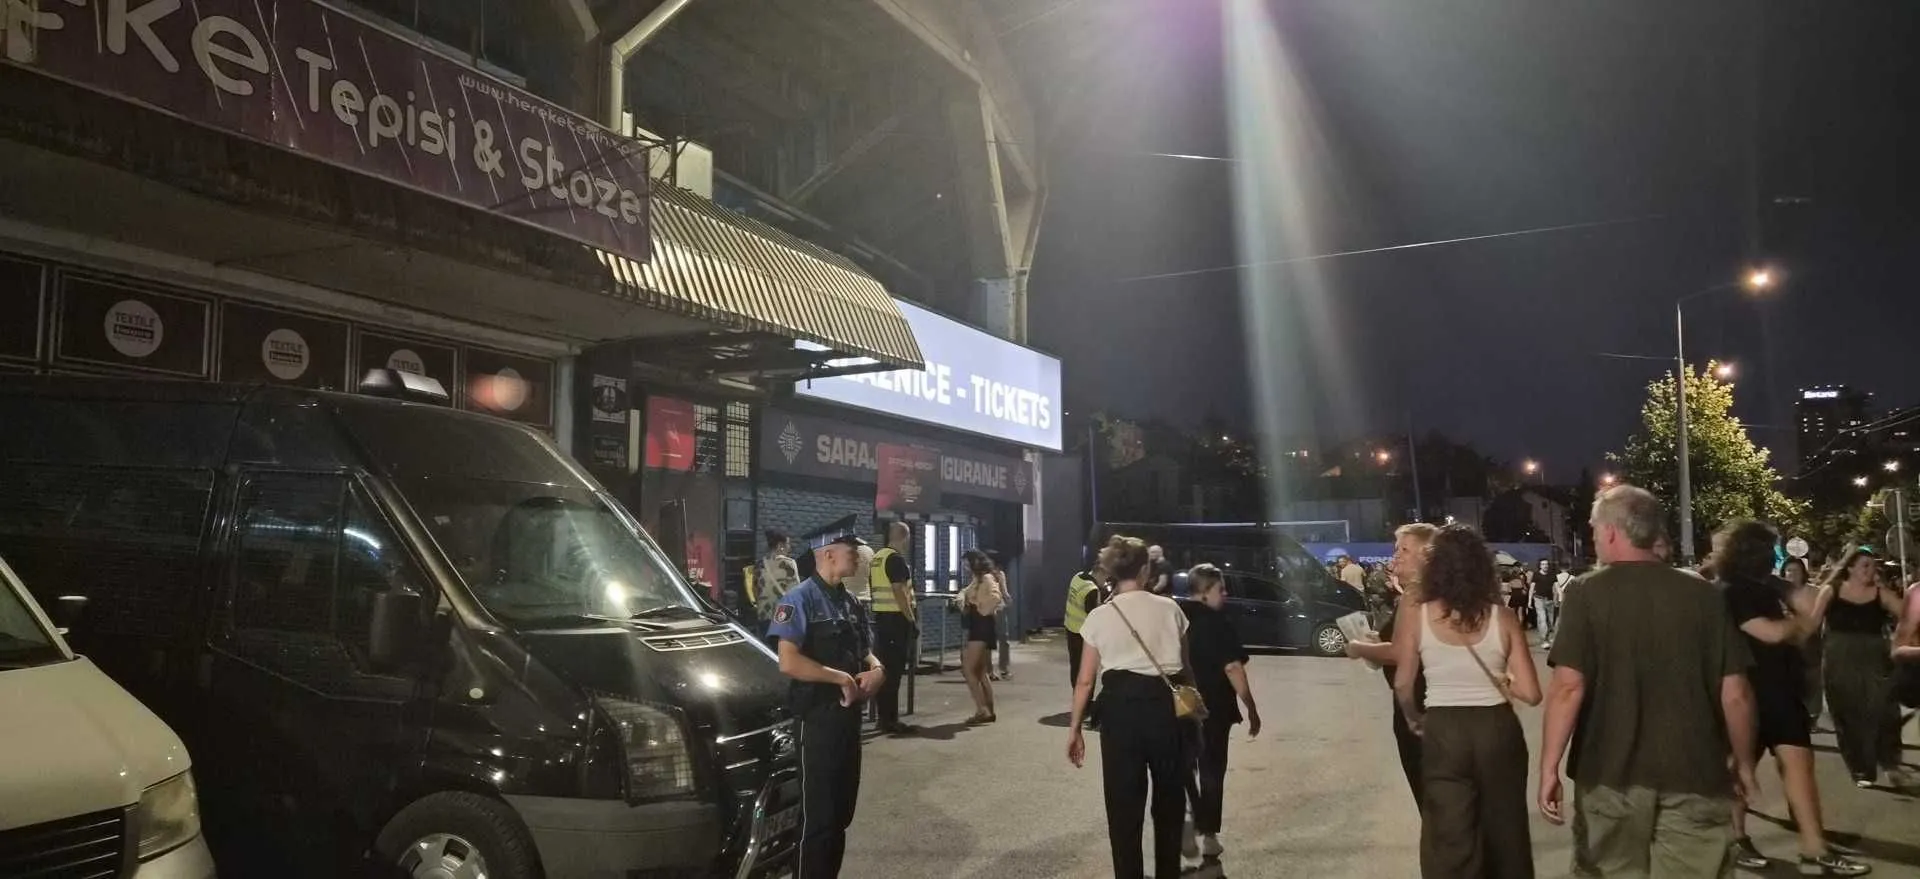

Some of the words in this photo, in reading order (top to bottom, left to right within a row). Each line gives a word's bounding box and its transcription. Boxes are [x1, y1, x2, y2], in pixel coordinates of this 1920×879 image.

[295, 47, 456, 161] Tepisi
[474, 119, 506, 178] &
[520, 137, 641, 225] Stoze
[115, 311, 156, 328] TEXTILE
[970, 374, 1051, 430] TICKETS
[816, 434, 879, 470] SARAJ
[940, 455, 1007, 489] IGURANJE
